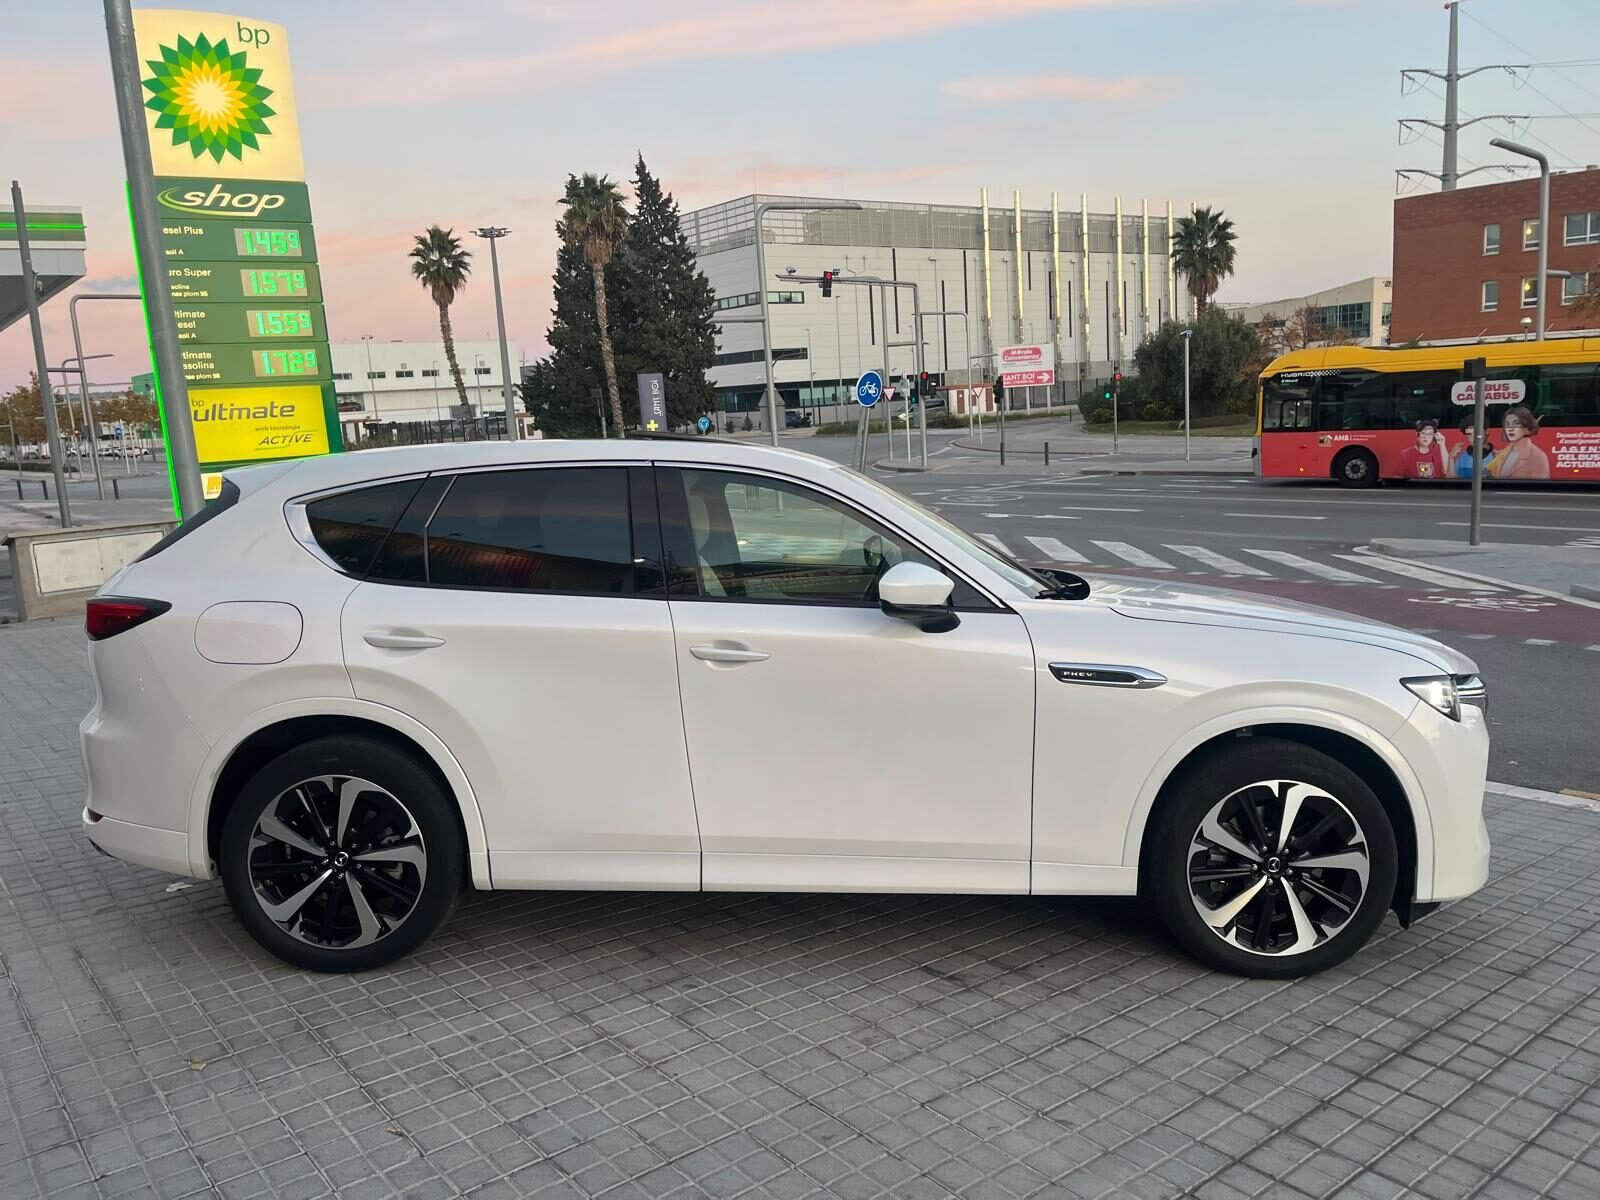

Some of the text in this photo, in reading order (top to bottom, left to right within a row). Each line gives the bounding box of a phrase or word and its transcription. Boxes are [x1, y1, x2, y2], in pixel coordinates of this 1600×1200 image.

[237, 22, 270, 48] bp
[183, 184, 285, 217] shop
[163, 226, 204, 235] esel Plus
[184, 268, 211, 278] Super
[174, 310, 206, 318] ltimate
[192, 399, 204, 408] bp
[193, 400, 295, 422] ultimate
[259, 432, 313, 446] ACTIVE
